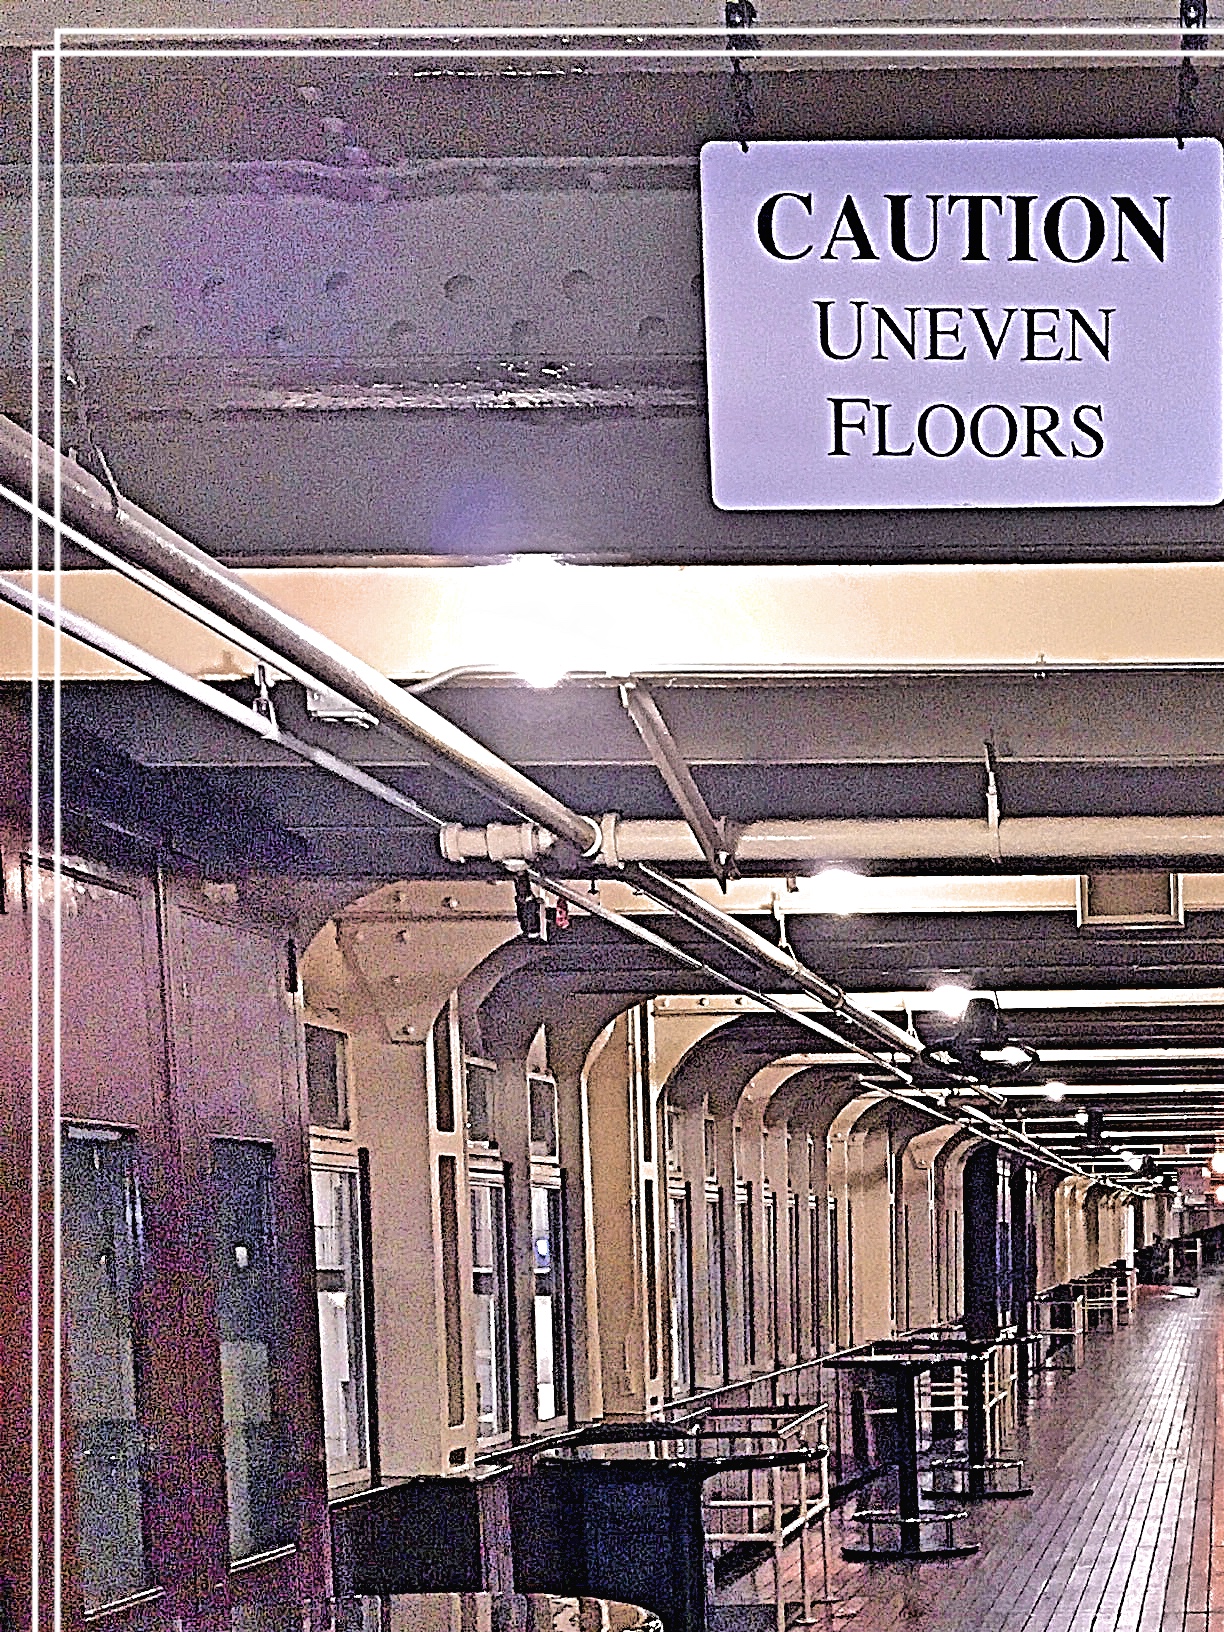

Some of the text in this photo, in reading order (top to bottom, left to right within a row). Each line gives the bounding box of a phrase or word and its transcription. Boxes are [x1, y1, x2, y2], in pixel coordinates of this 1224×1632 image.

[756, 192, 1171, 264] CAUTION
[813, 300, 1116, 361] UNEVEN
[827, 397, 1104, 458] FLOORS
